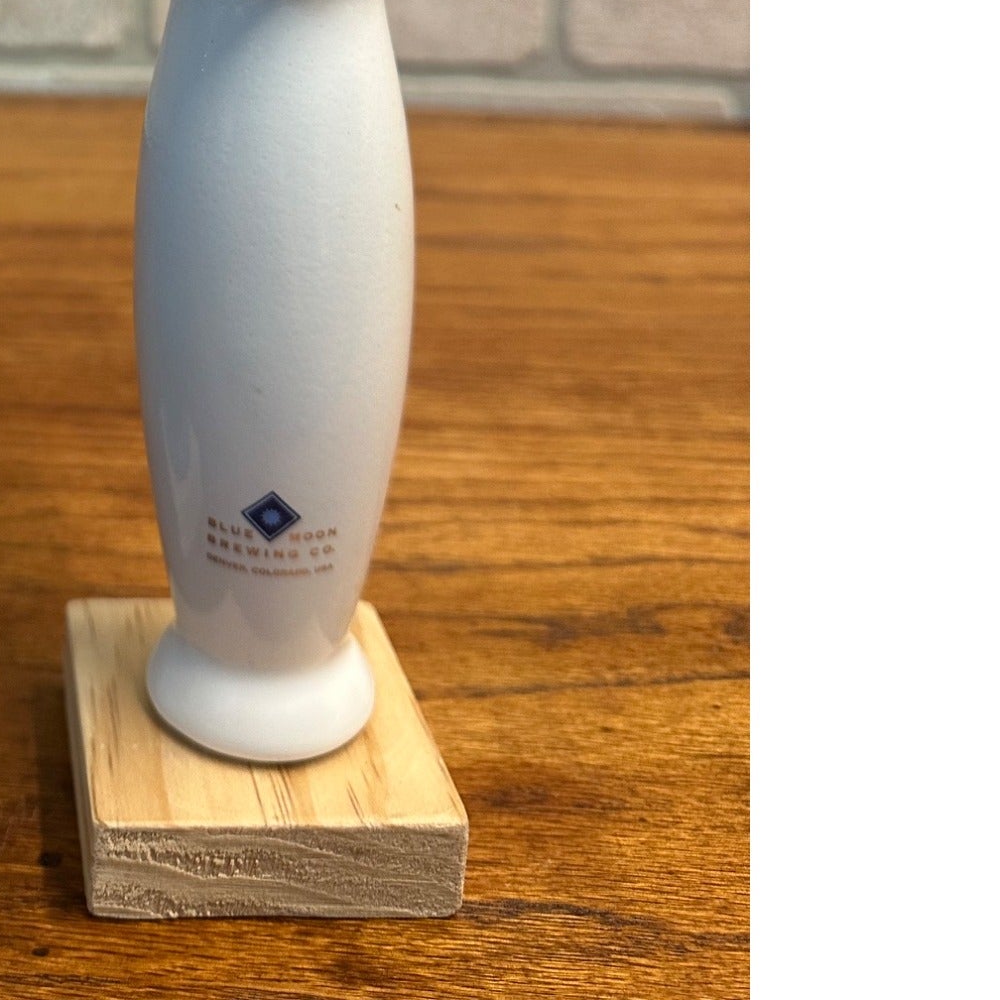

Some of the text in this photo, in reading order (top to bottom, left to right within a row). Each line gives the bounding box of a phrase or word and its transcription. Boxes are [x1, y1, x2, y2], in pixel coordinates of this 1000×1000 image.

[207, 516, 337, 542] BLUE MOON
[206, 532, 299, 559] BREWING
